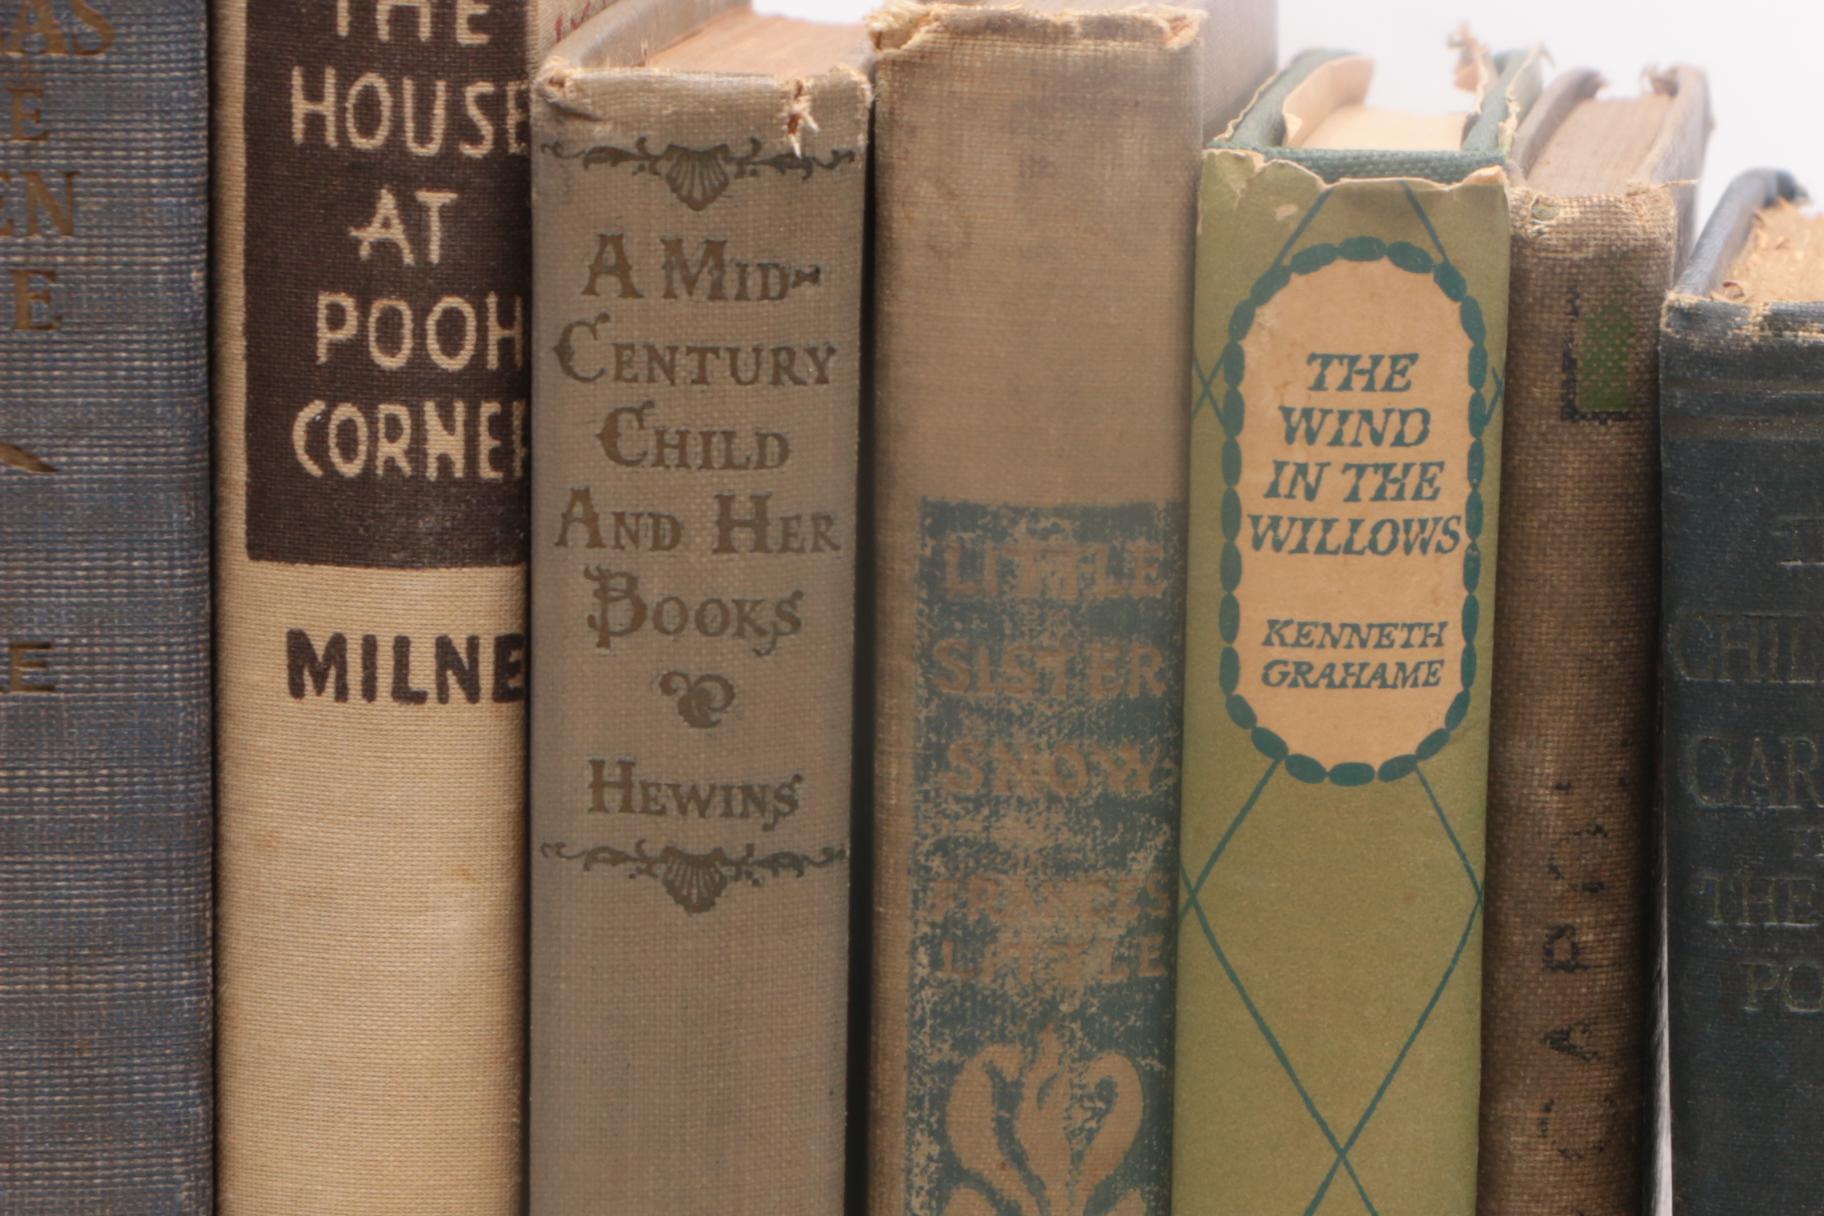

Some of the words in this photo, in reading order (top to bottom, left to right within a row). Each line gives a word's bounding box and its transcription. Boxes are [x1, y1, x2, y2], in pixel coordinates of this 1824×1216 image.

[291, 65, 529, 158] HOUSE
[349, 186, 457, 264] AT
[581, 232, 643, 301] A
[316, 290, 522, 371] POOH
[1306, 352, 1420, 392] THE
[1278, 406, 1431, 447] WIND
[1263, 460, 1330, 500] IN
[1342, 460, 1445, 502] THE
[1247, 514, 1462, 556] WILLOWS
[1261, 619, 1448, 650] KENNETH
[286, 628, 524, 704] MILNE
[931, 637, 1168, 697] SISTER
[1261, 660, 1445, 689] GRAHAME
[940, 735, 1160, 798] SNOW
[1698, 873, 1822, 928] THE
